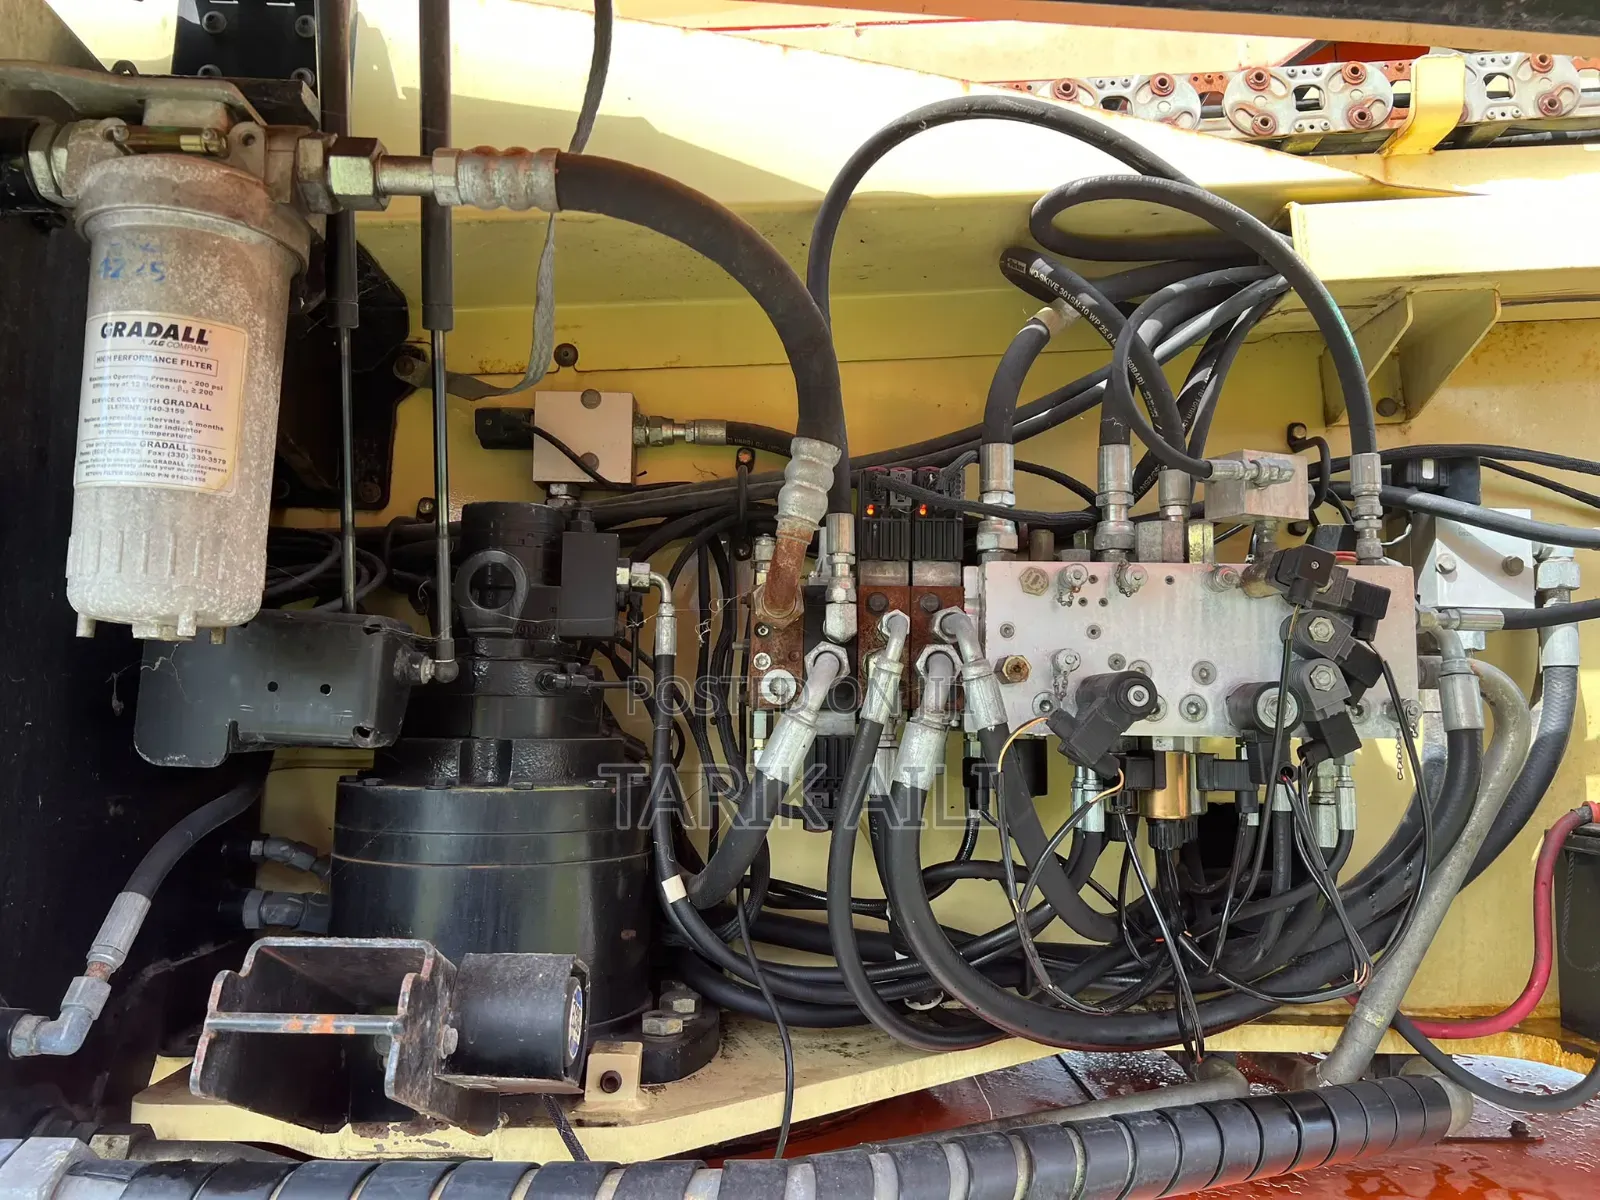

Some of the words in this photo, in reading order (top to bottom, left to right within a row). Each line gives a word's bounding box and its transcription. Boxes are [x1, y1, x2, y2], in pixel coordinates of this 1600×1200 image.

[1088, 313, 1101, 325] WP
[100, 321, 209, 346] GRADALL
[147, 339, 166, 347] JLG
[166, 340, 210, 353] COMPANY
[113, 354, 178, 365] PERFORMANCE
[180, 358, 213, 371] FILTER
[150, 375, 187, 384] Pressure
[194, 380, 210, 388] 200
[211, 384, 223, 392] psi
[198, 388, 214, 396] 200
[162, 398, 212, 412] GRADALL
[164, 424, 203, 434] indicator
[195, 422, 224, 432] months
[141, 430, 193, 440] temperature
[139, 440, 189, 452] GRADALL
[167, 450, 189, 460] (330)
